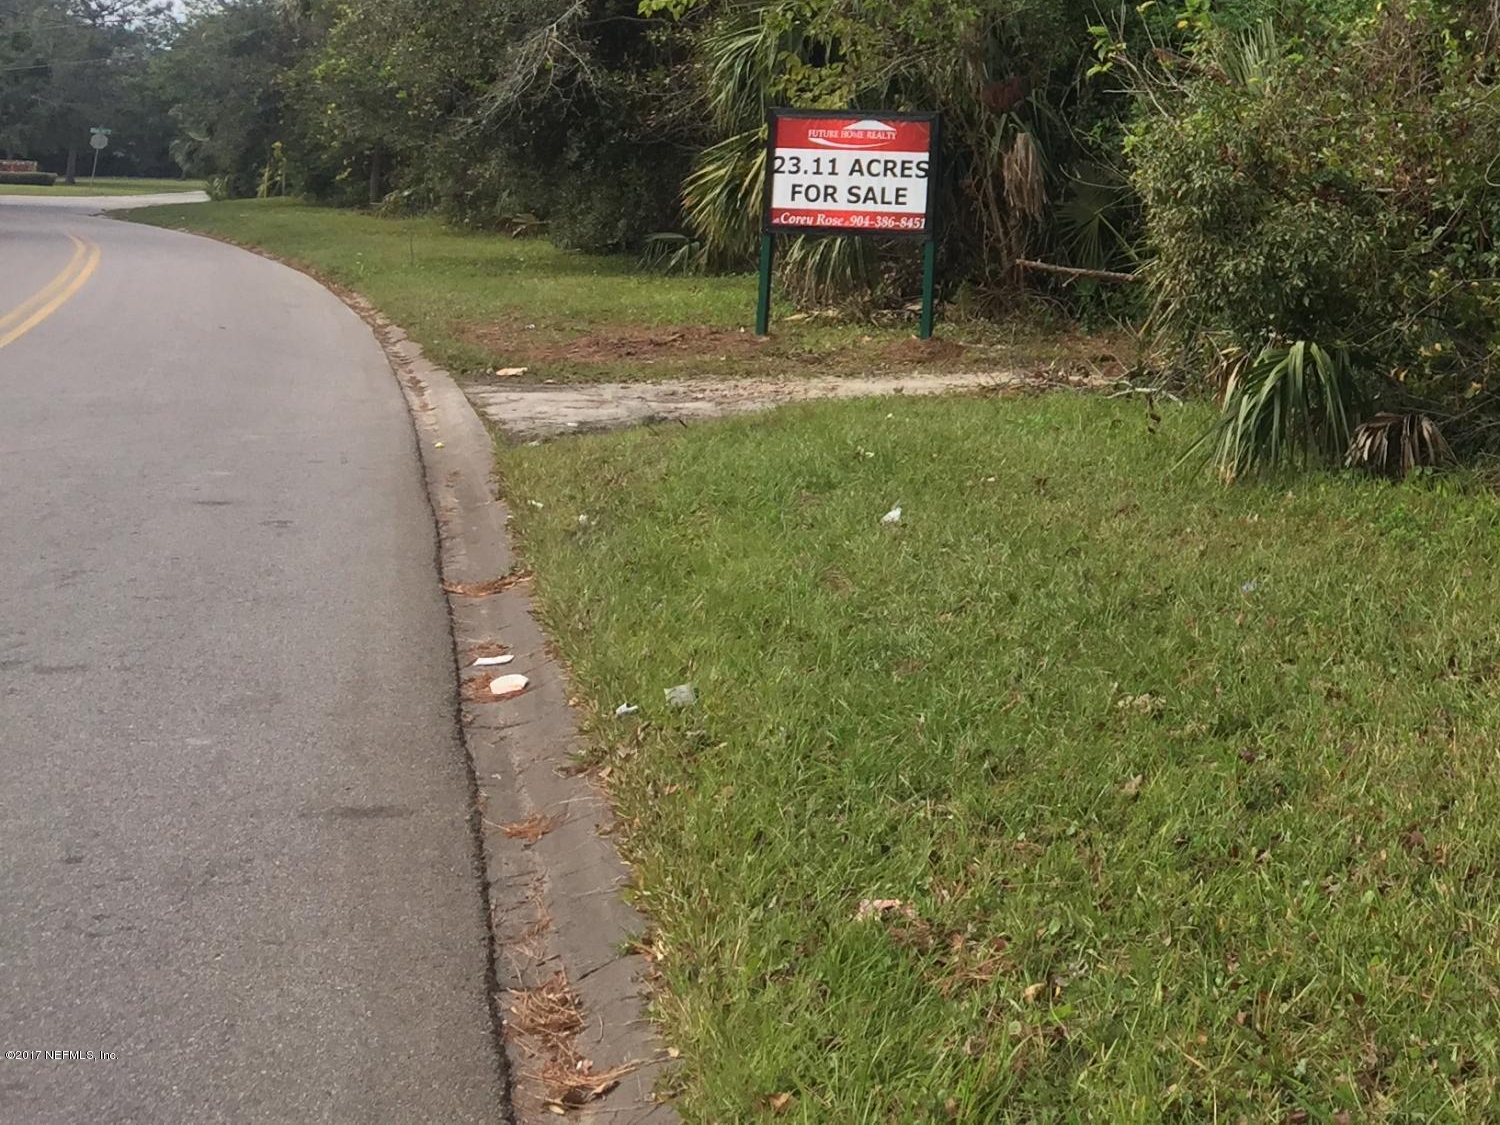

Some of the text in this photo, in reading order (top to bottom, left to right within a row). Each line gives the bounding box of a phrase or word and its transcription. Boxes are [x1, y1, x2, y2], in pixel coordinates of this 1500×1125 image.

[808, 129, 897, 140] FUTURE HOME REALTY
[774, 155, 930, 179] 23.11 ACRES
[790, 183, 908, 206] FOR SALE
[816, 213, 844, 226] Rose
[850, 215, 926, 229] 904-386-8451
